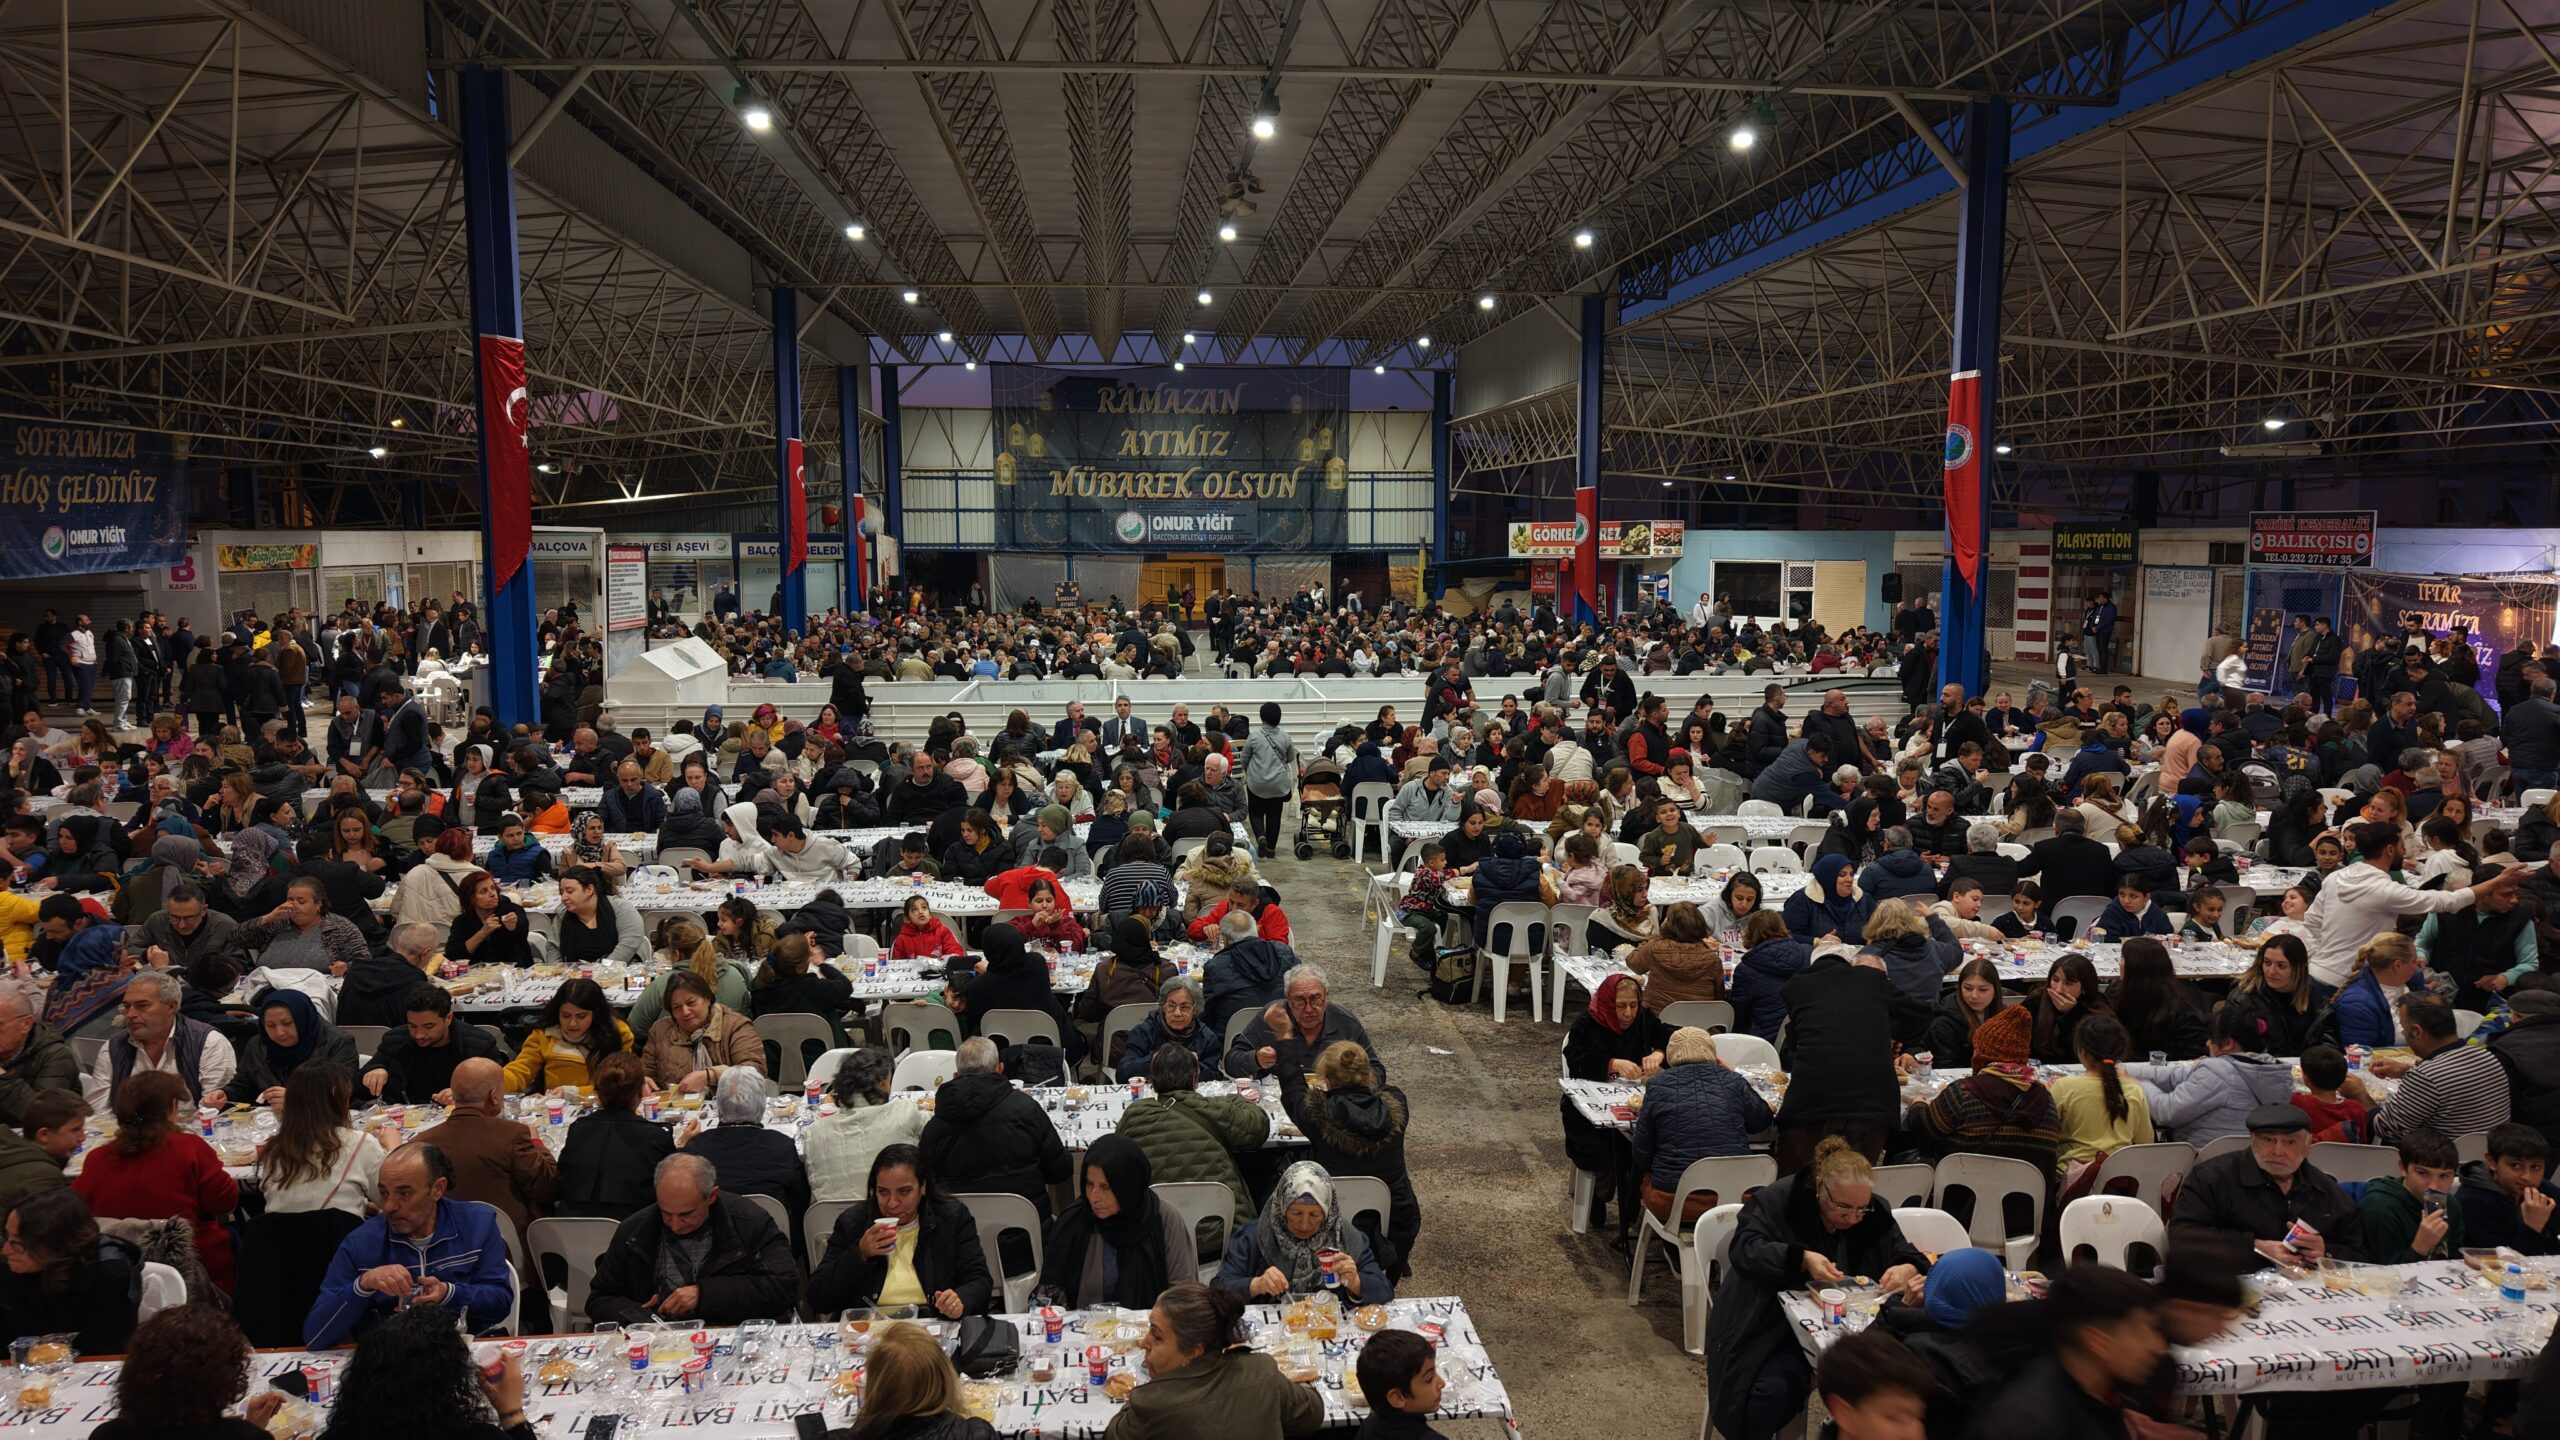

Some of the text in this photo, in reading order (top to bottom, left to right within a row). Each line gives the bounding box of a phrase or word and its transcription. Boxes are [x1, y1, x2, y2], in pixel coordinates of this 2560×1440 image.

[1097, 382, 1248, 414] RAMAZAN
[15, 425, 137, 459] SOFRAMIZA
[1118, 424, 1230, 457] AYIMIZ
[1, 467, 158, 513] HOŞ GELDİNİZ
[1049, 465, 1306, 499] MÜBAREK OLSUN
[1152, 516, 1193, 531] ONUR
[1196, 512, 1234, 531] YİĞİT
[70, 524, 126, 545] ONUR YİĞİT
[1600, 527, 1621, 541] REZ
[2266, 534, 2354, 552] BALIKÇISI
[676, 540, 710, 552] AŞEVİ
[747, 545, 780, 557] BALÇ
[2264, 553, 2351, 564] TEL:0.232 271 47 35
[171, 556, 195, 582] B
[2335, 1371, 2397, 1382] MUTFAK
[1023, 1387, 1089, 1407] BATI
